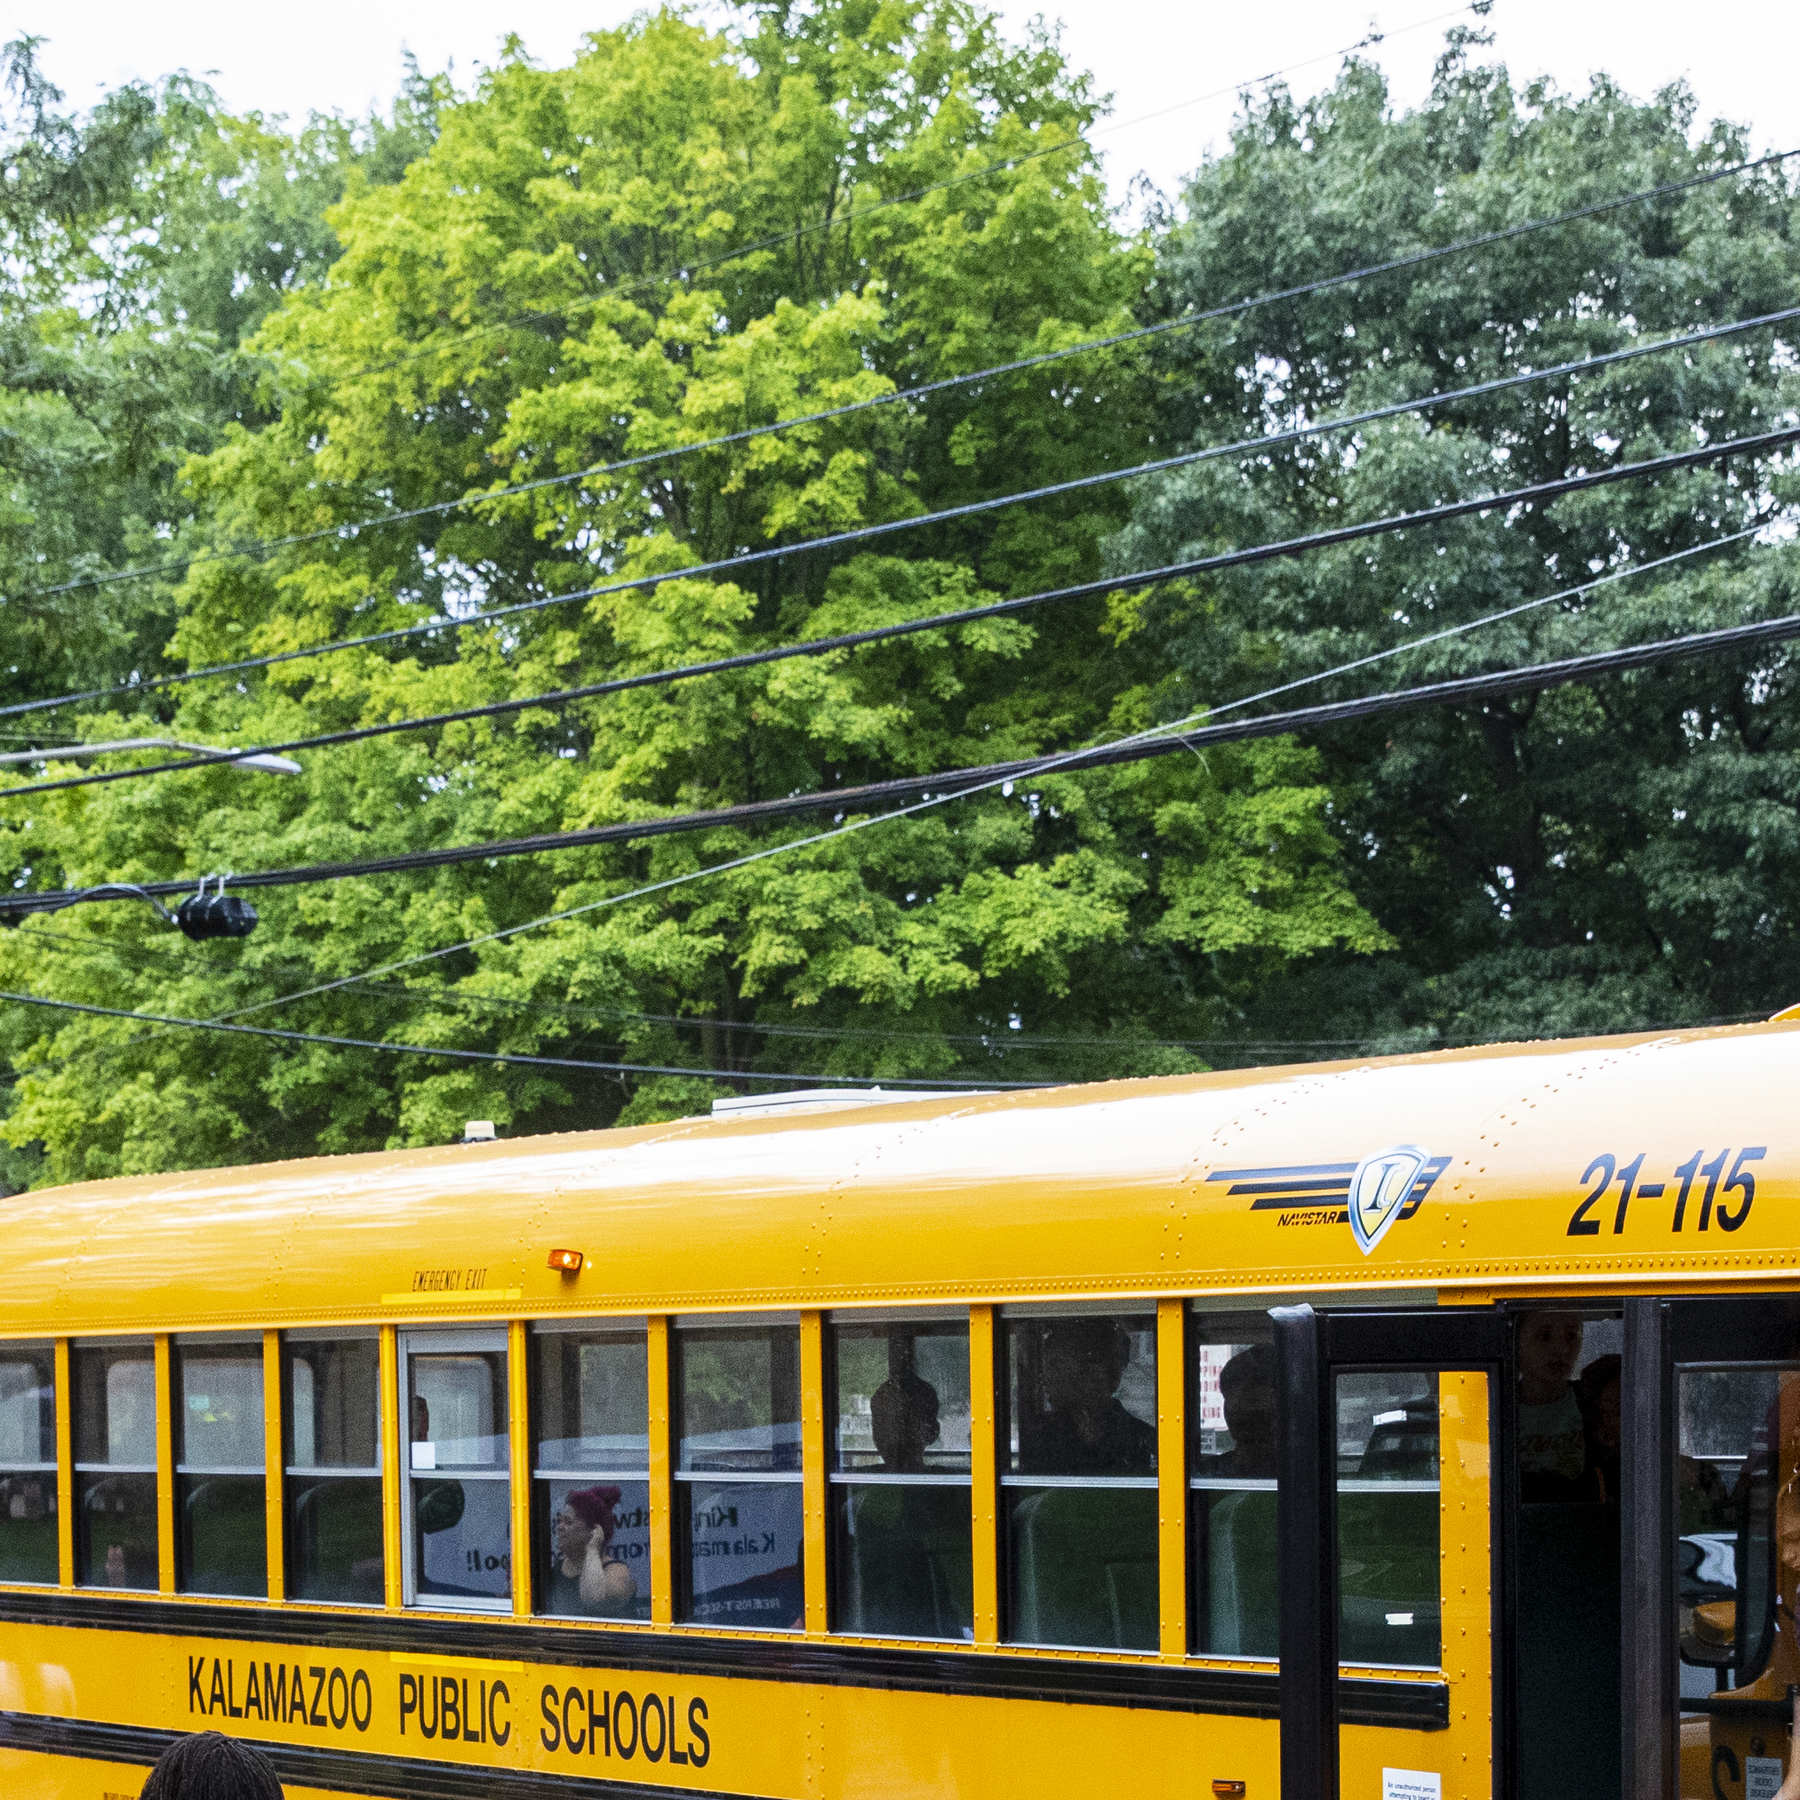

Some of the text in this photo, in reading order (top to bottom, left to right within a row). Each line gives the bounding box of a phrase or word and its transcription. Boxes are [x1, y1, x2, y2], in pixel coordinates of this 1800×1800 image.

[1277, 1211, 1337, 1226] NAVISTAR
[1567, 1146, 1767, 1236] 21-115
[412, 1268, 487, 1292] EMERGENCY EXIT
[189, 1655, 710, 1768] KALAMAZOO PUBLIC SCHOOLS
